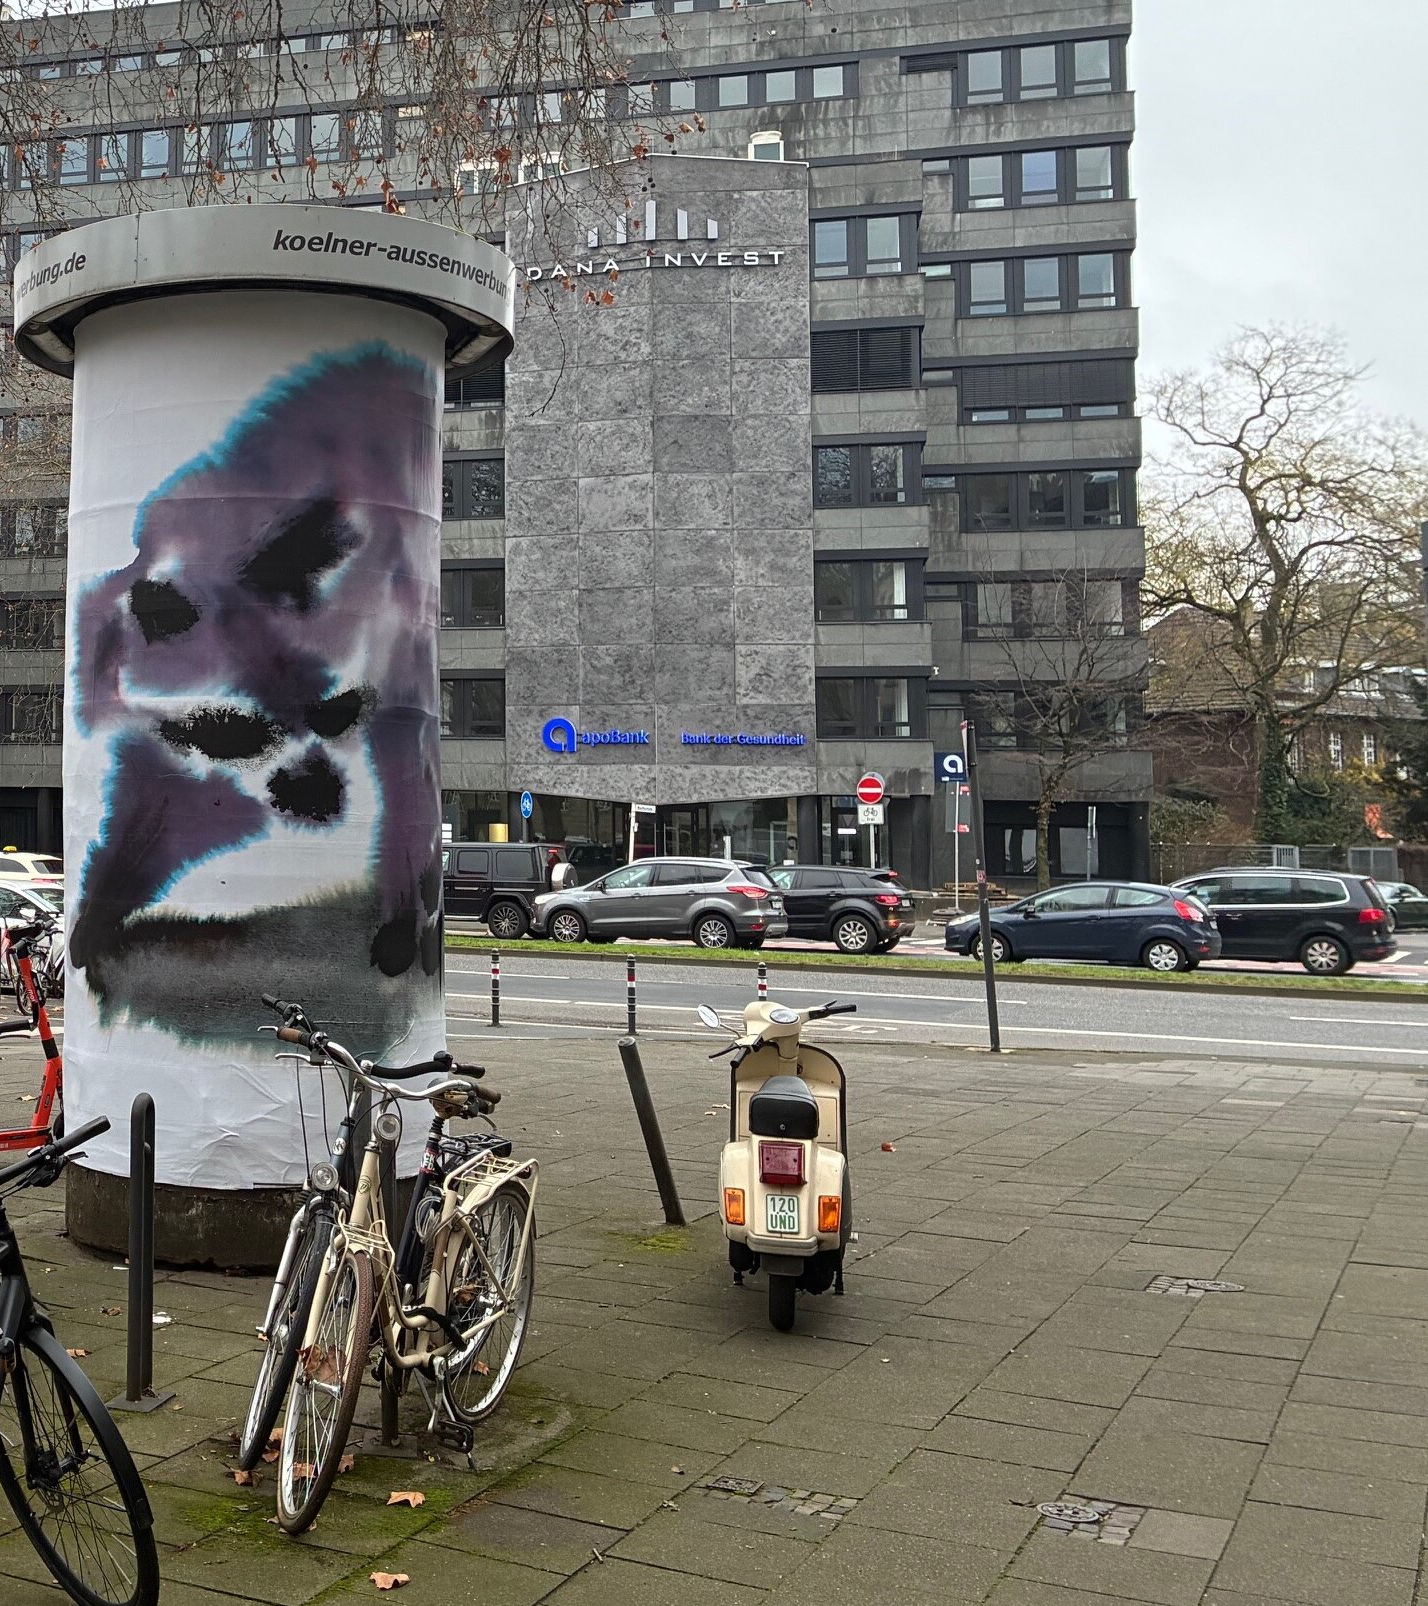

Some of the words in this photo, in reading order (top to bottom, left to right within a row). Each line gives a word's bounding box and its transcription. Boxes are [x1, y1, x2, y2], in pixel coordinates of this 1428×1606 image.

[273, 230, 510, 300] koelner-aussenwerbun
[526, 257, 620, 281] DANA
[645, 250, 785, 268] INVEST
[581, 729, 650, 747] apoBank
[681, 732, 710, 745] Bank
[713, 732, 734, 745] der
[736, 733, 807, 746] Gesundheit
[770, 1196, 795, 1213] 120
[770, 1213, 795, 1230] UND
